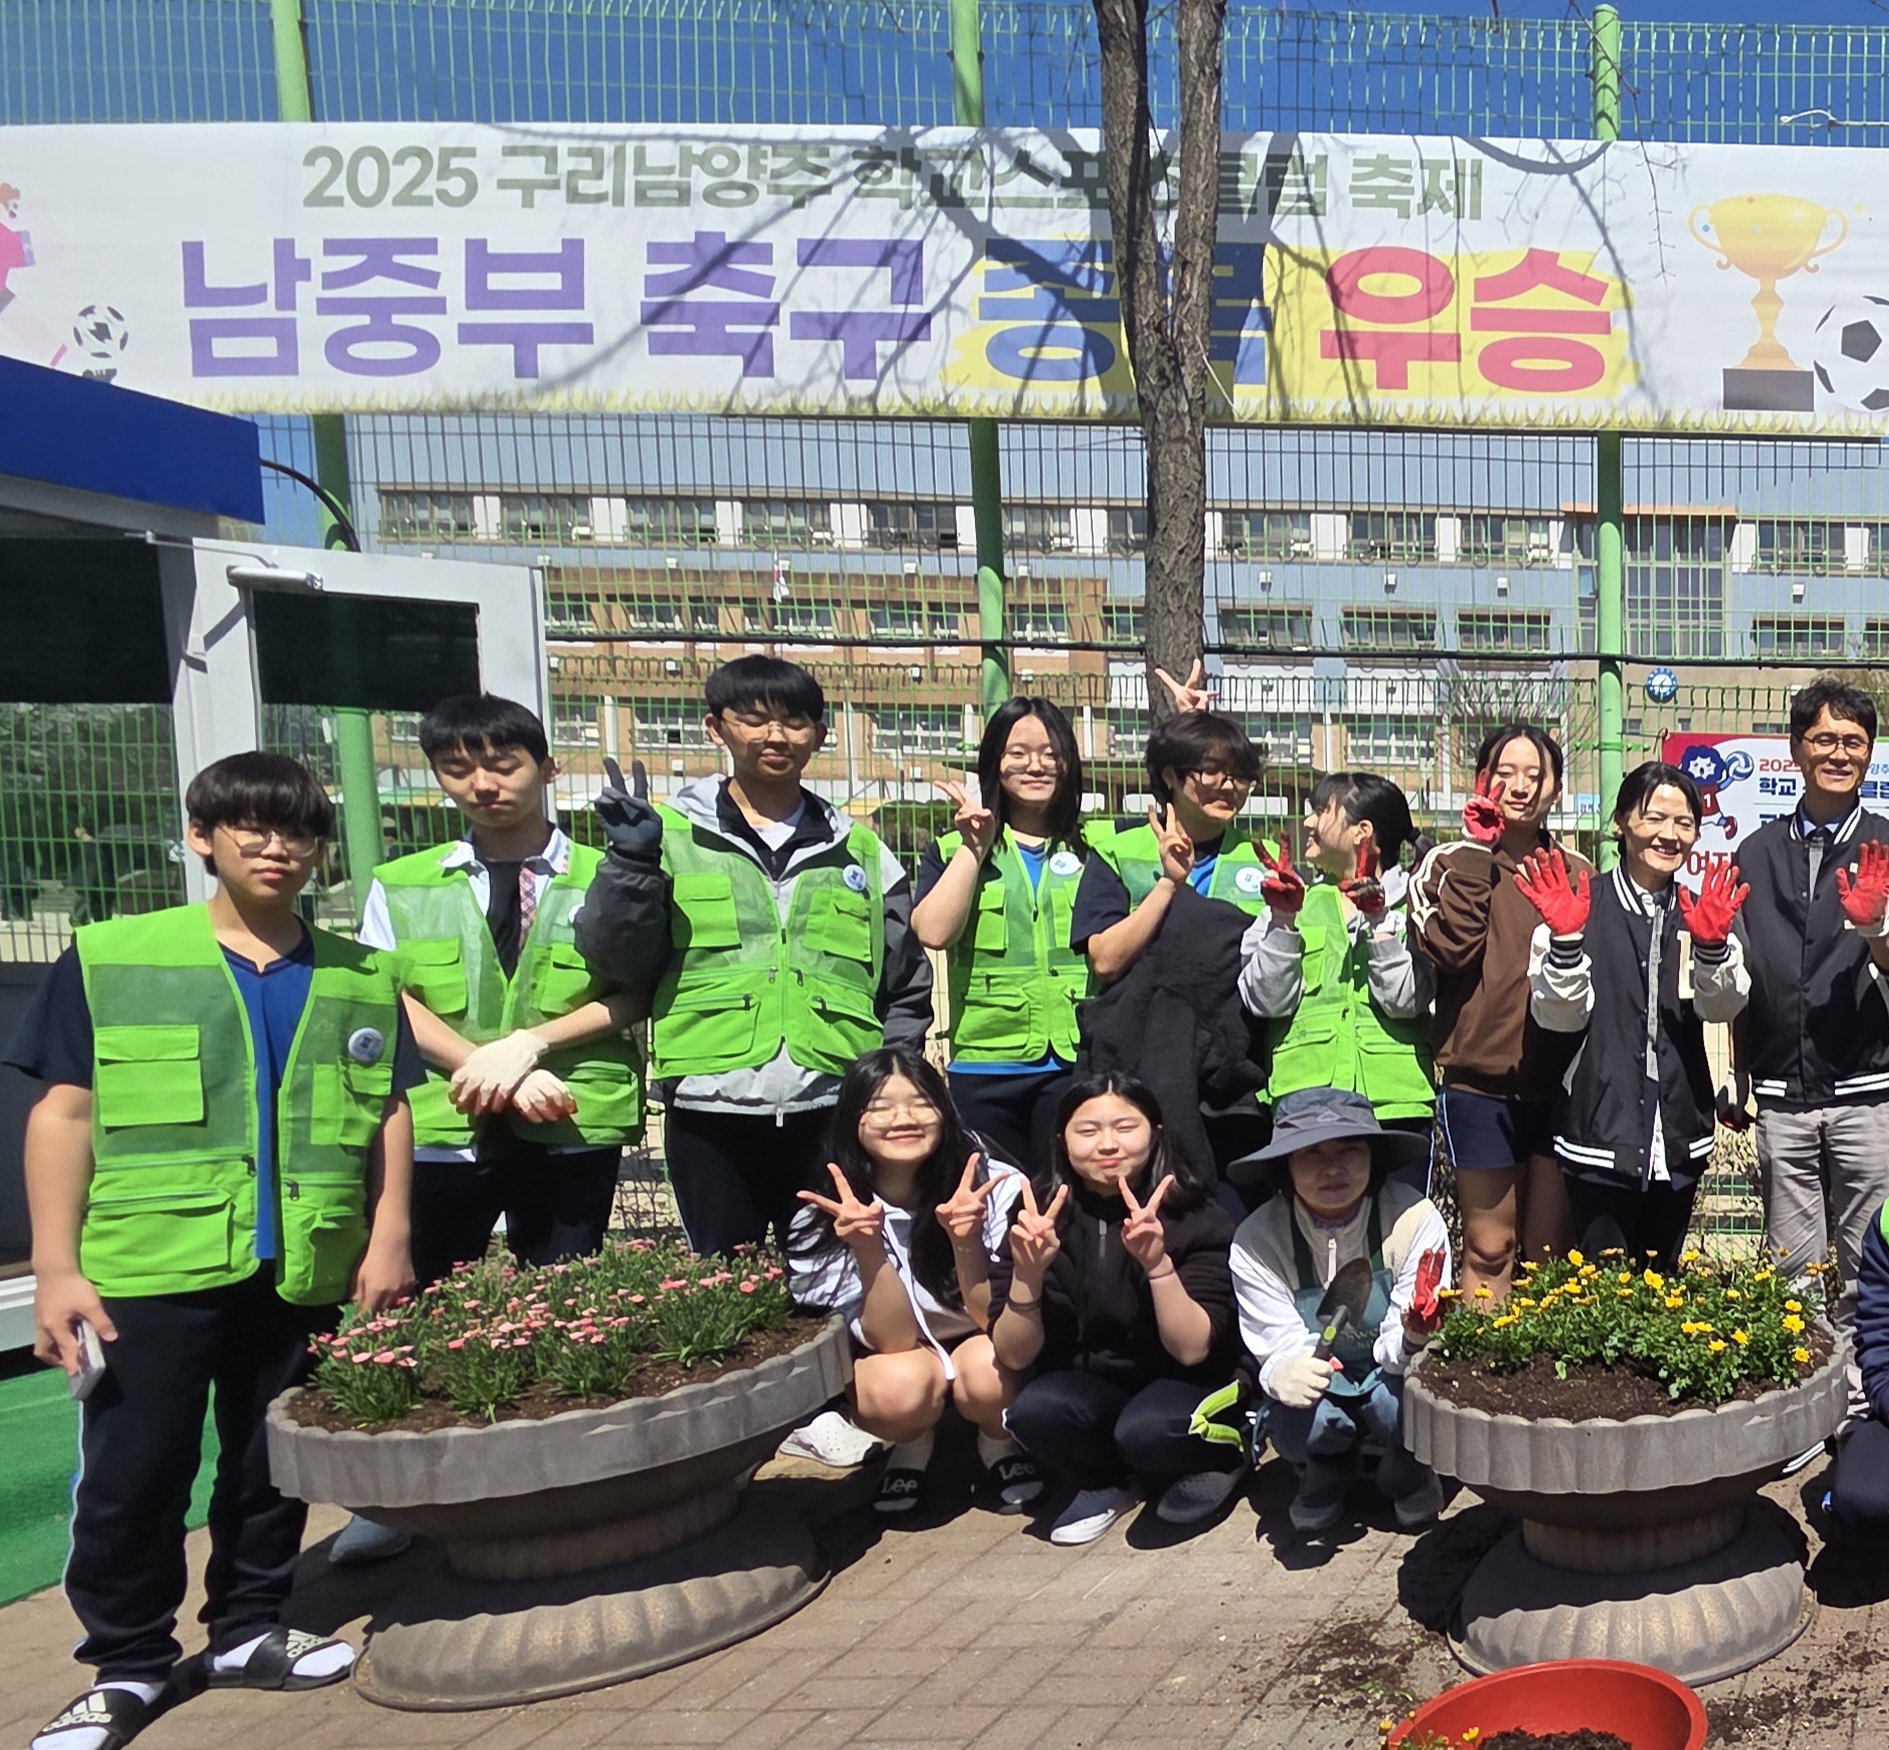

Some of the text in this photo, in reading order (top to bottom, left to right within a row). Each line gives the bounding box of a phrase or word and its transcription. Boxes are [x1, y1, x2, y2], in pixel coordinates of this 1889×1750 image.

[302, 145, 478, 208] 2025
[496, 142, 831, 210] 구리남양주
[1349, 153, 1483, 221] 축제
[181, 236, 595, 380] 남중부
[640, 230, 932, 381] 축구
[1319, 245, 1612, 397] 우승
[1759, 777, 1797, 797] 학교
[998, 1462, 1036, 1481] Lee
[881, 1476, 918, 1494] Lee
[42, 1711, 113, 1732] adidas
